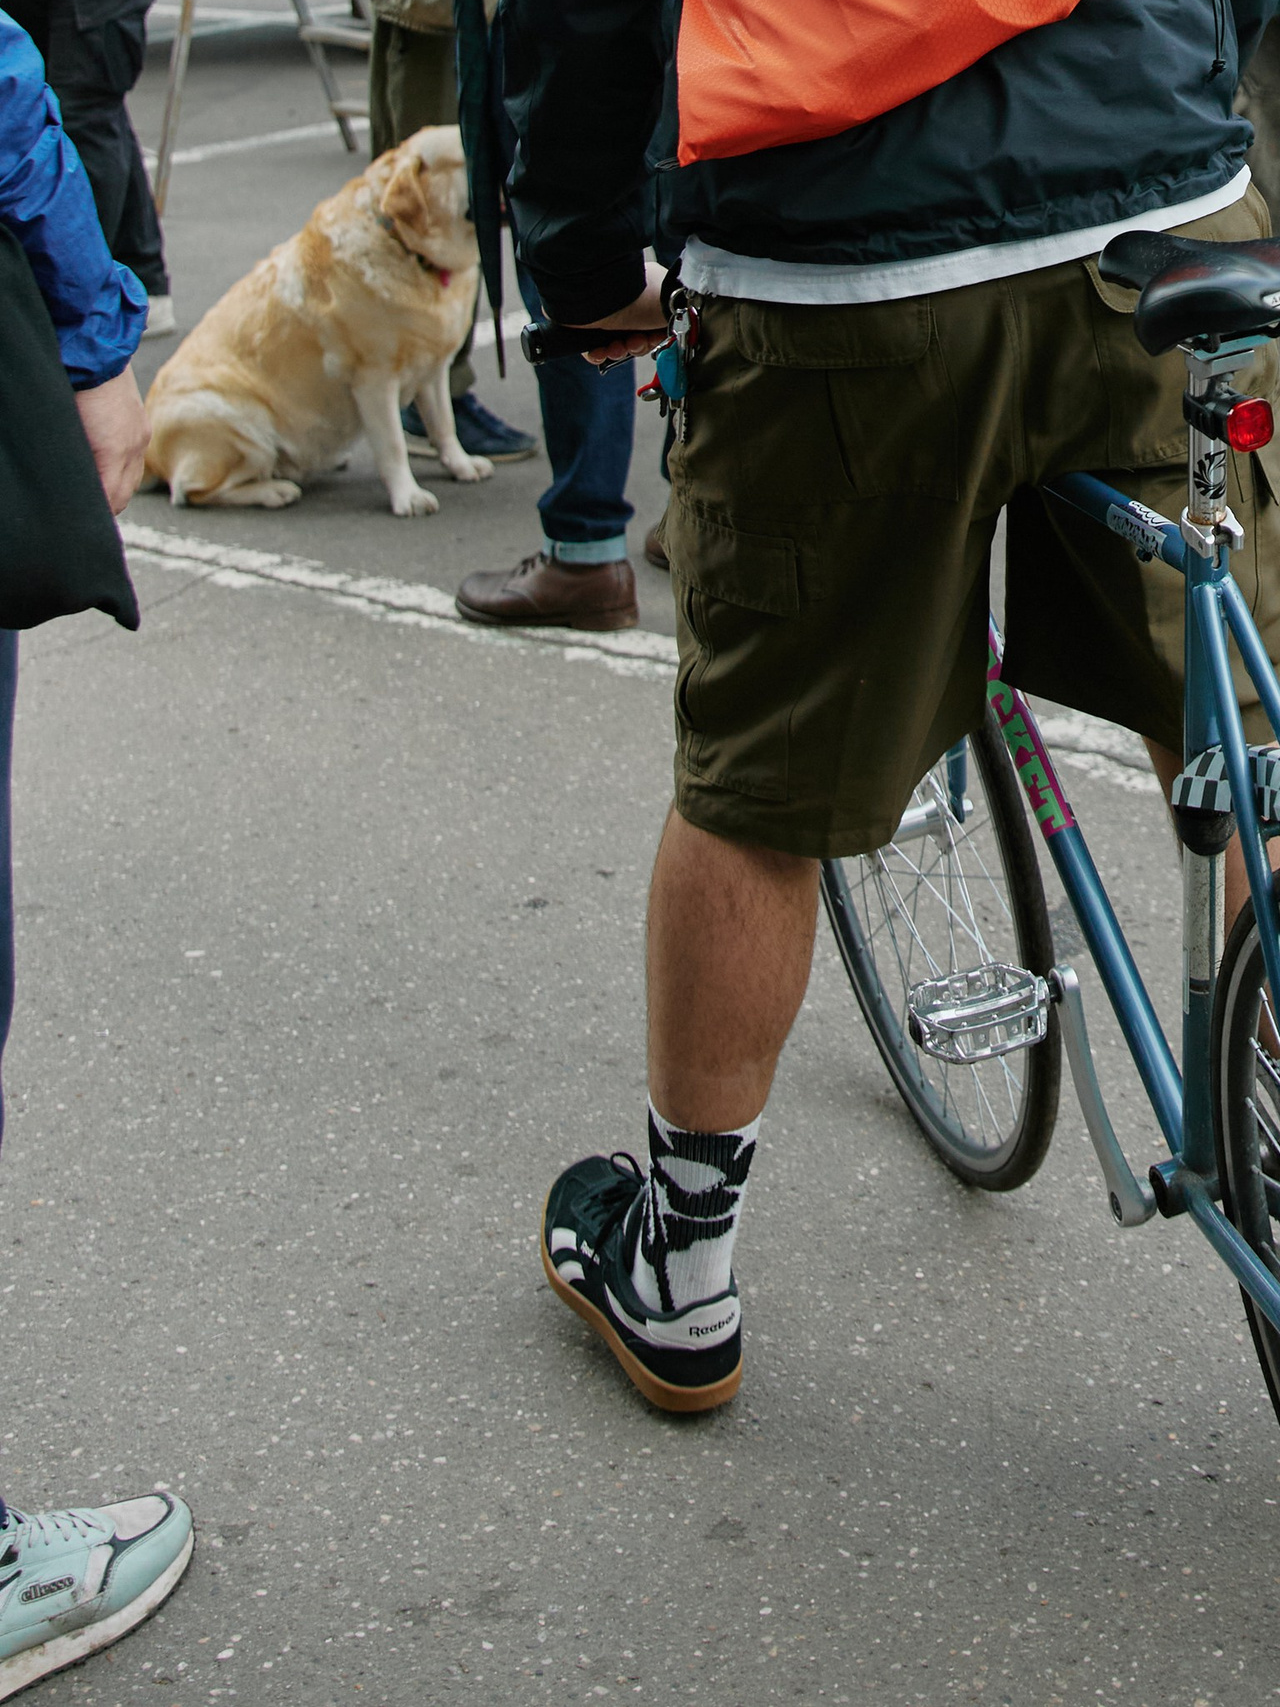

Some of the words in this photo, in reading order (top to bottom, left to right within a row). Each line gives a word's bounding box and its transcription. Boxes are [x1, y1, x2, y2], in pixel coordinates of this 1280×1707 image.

[986, 645, 1067, 830] CKET
[689, 1310, 736, 1338] Reebok
[21, 1575, 75, 1602] ellesse
